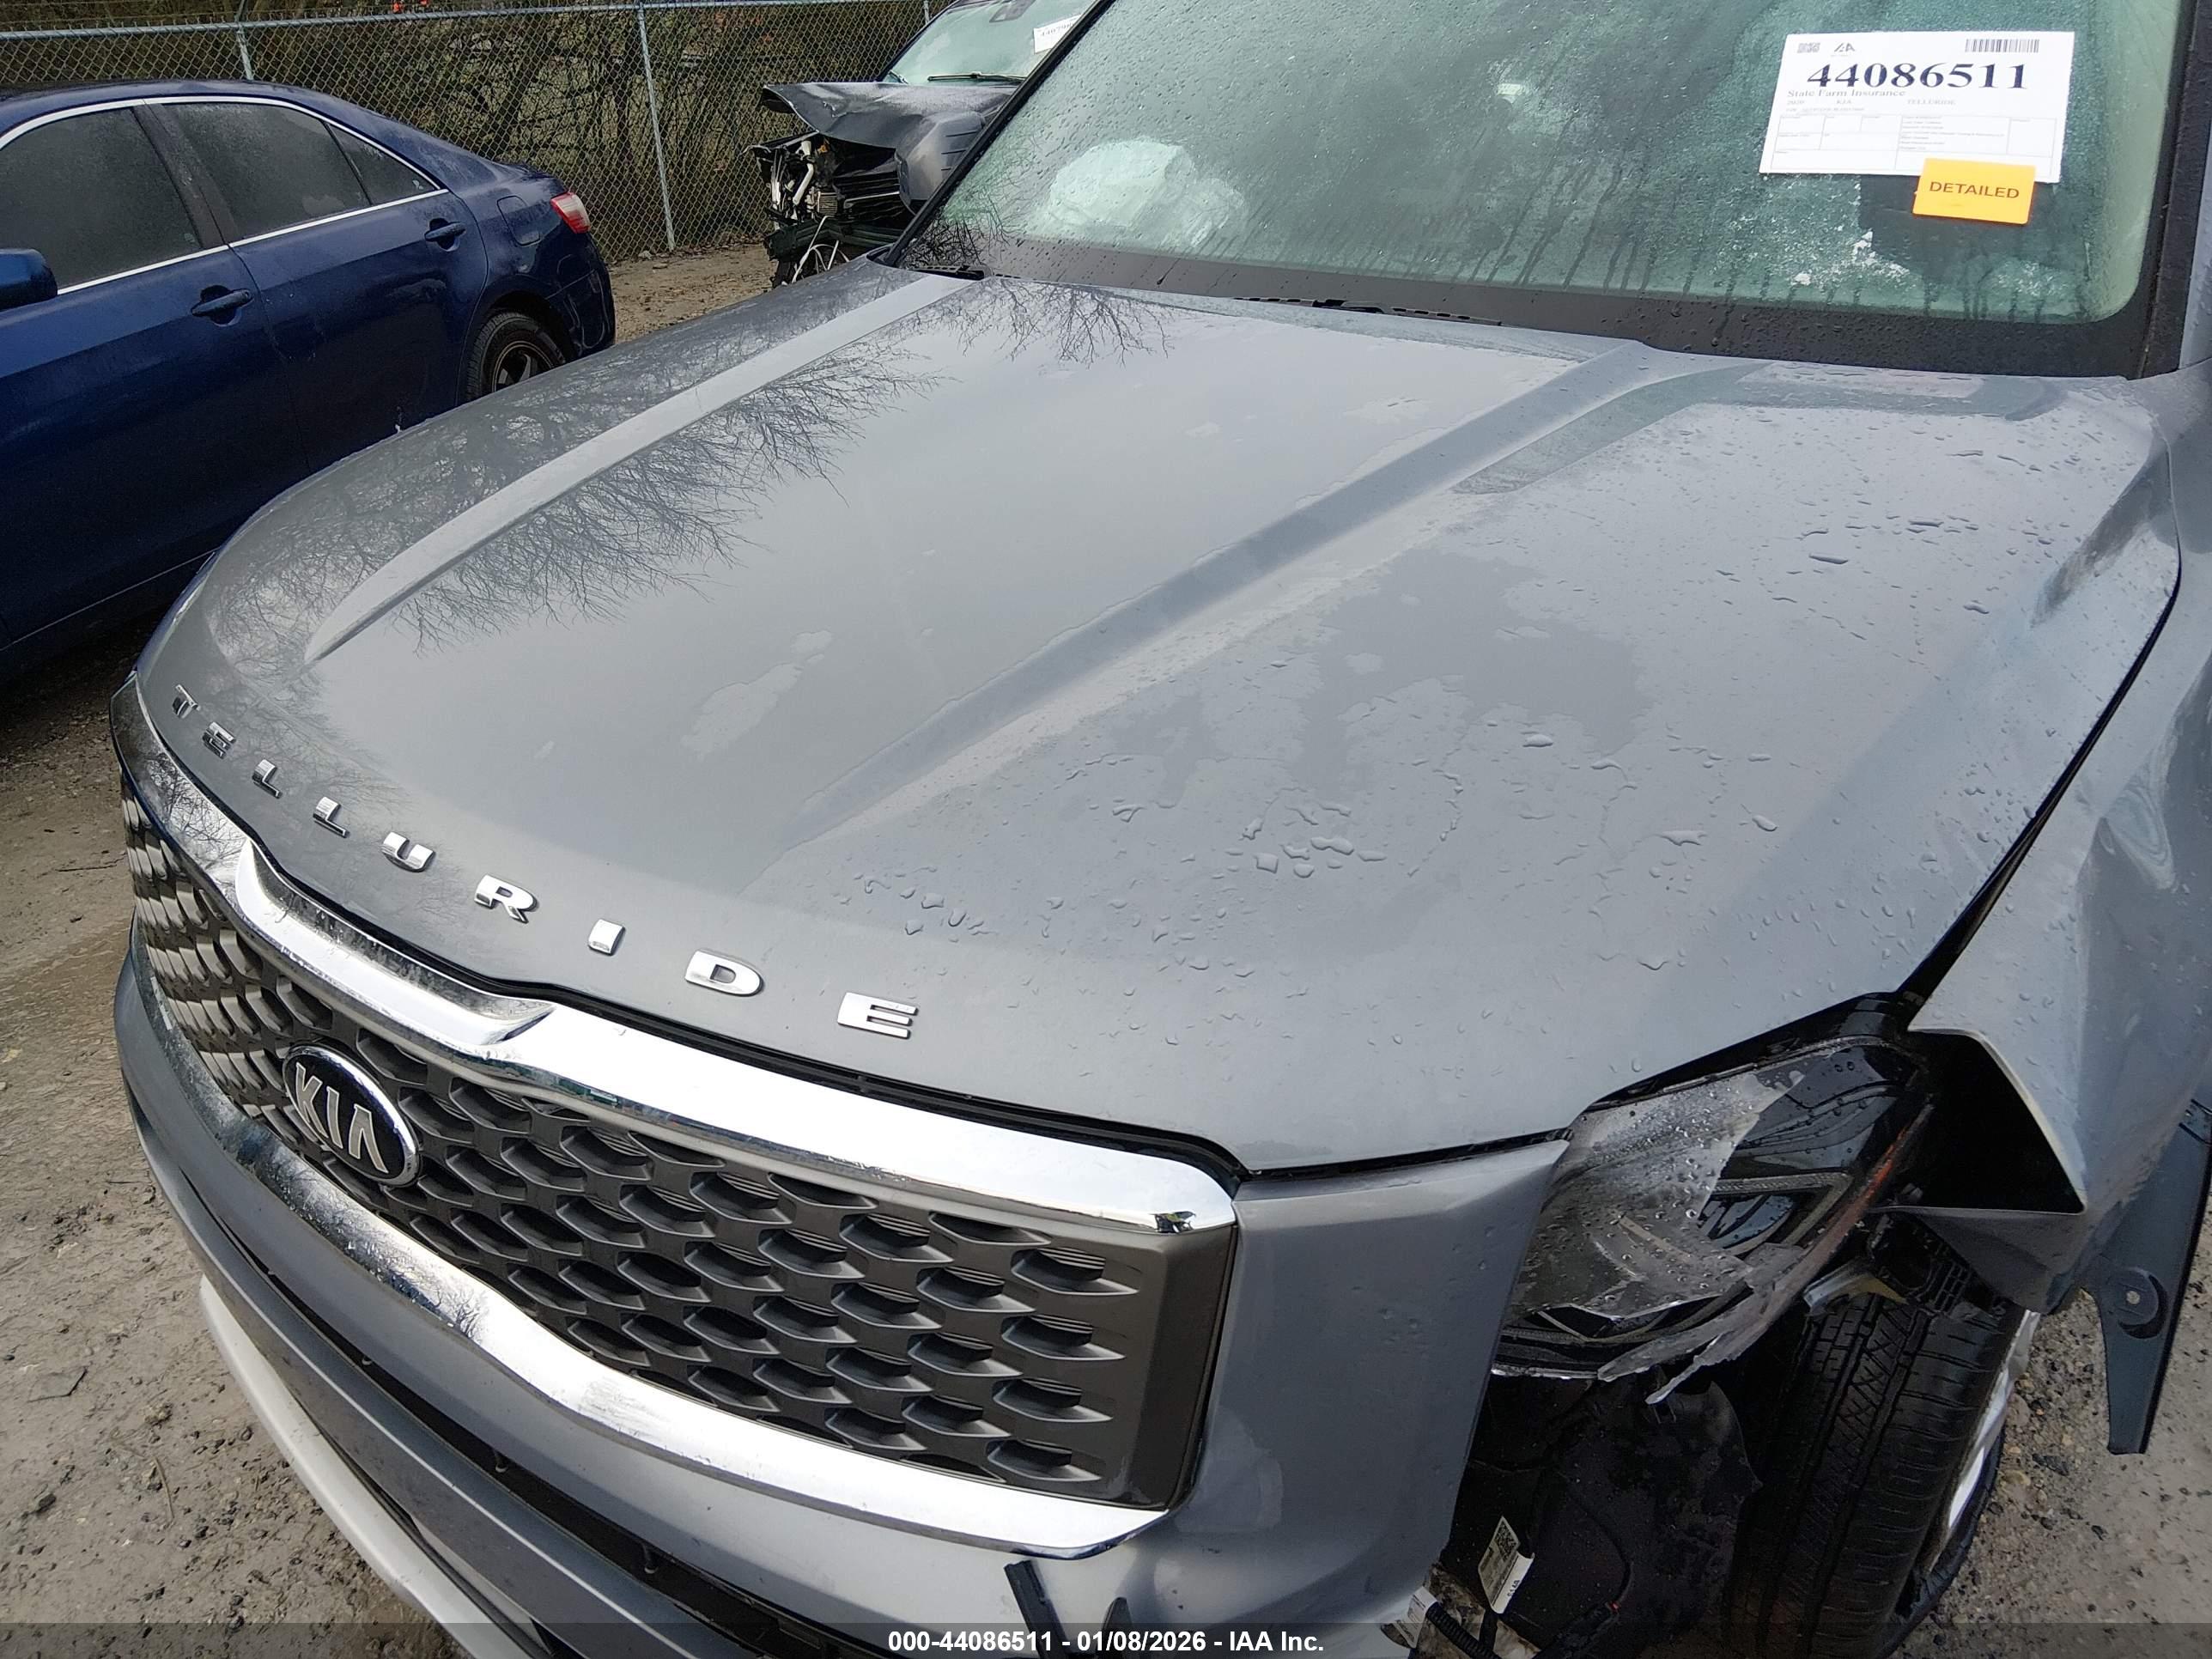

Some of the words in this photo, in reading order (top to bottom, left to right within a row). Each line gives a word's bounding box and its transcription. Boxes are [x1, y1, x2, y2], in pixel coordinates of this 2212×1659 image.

[1807, 63, 2028, 88] 44086511
[1929, 181, 2020, 199] DETAILED
[171, 684, 920, 1038] TELLURIDE
[295, 1061, 389, 1174] KIA
